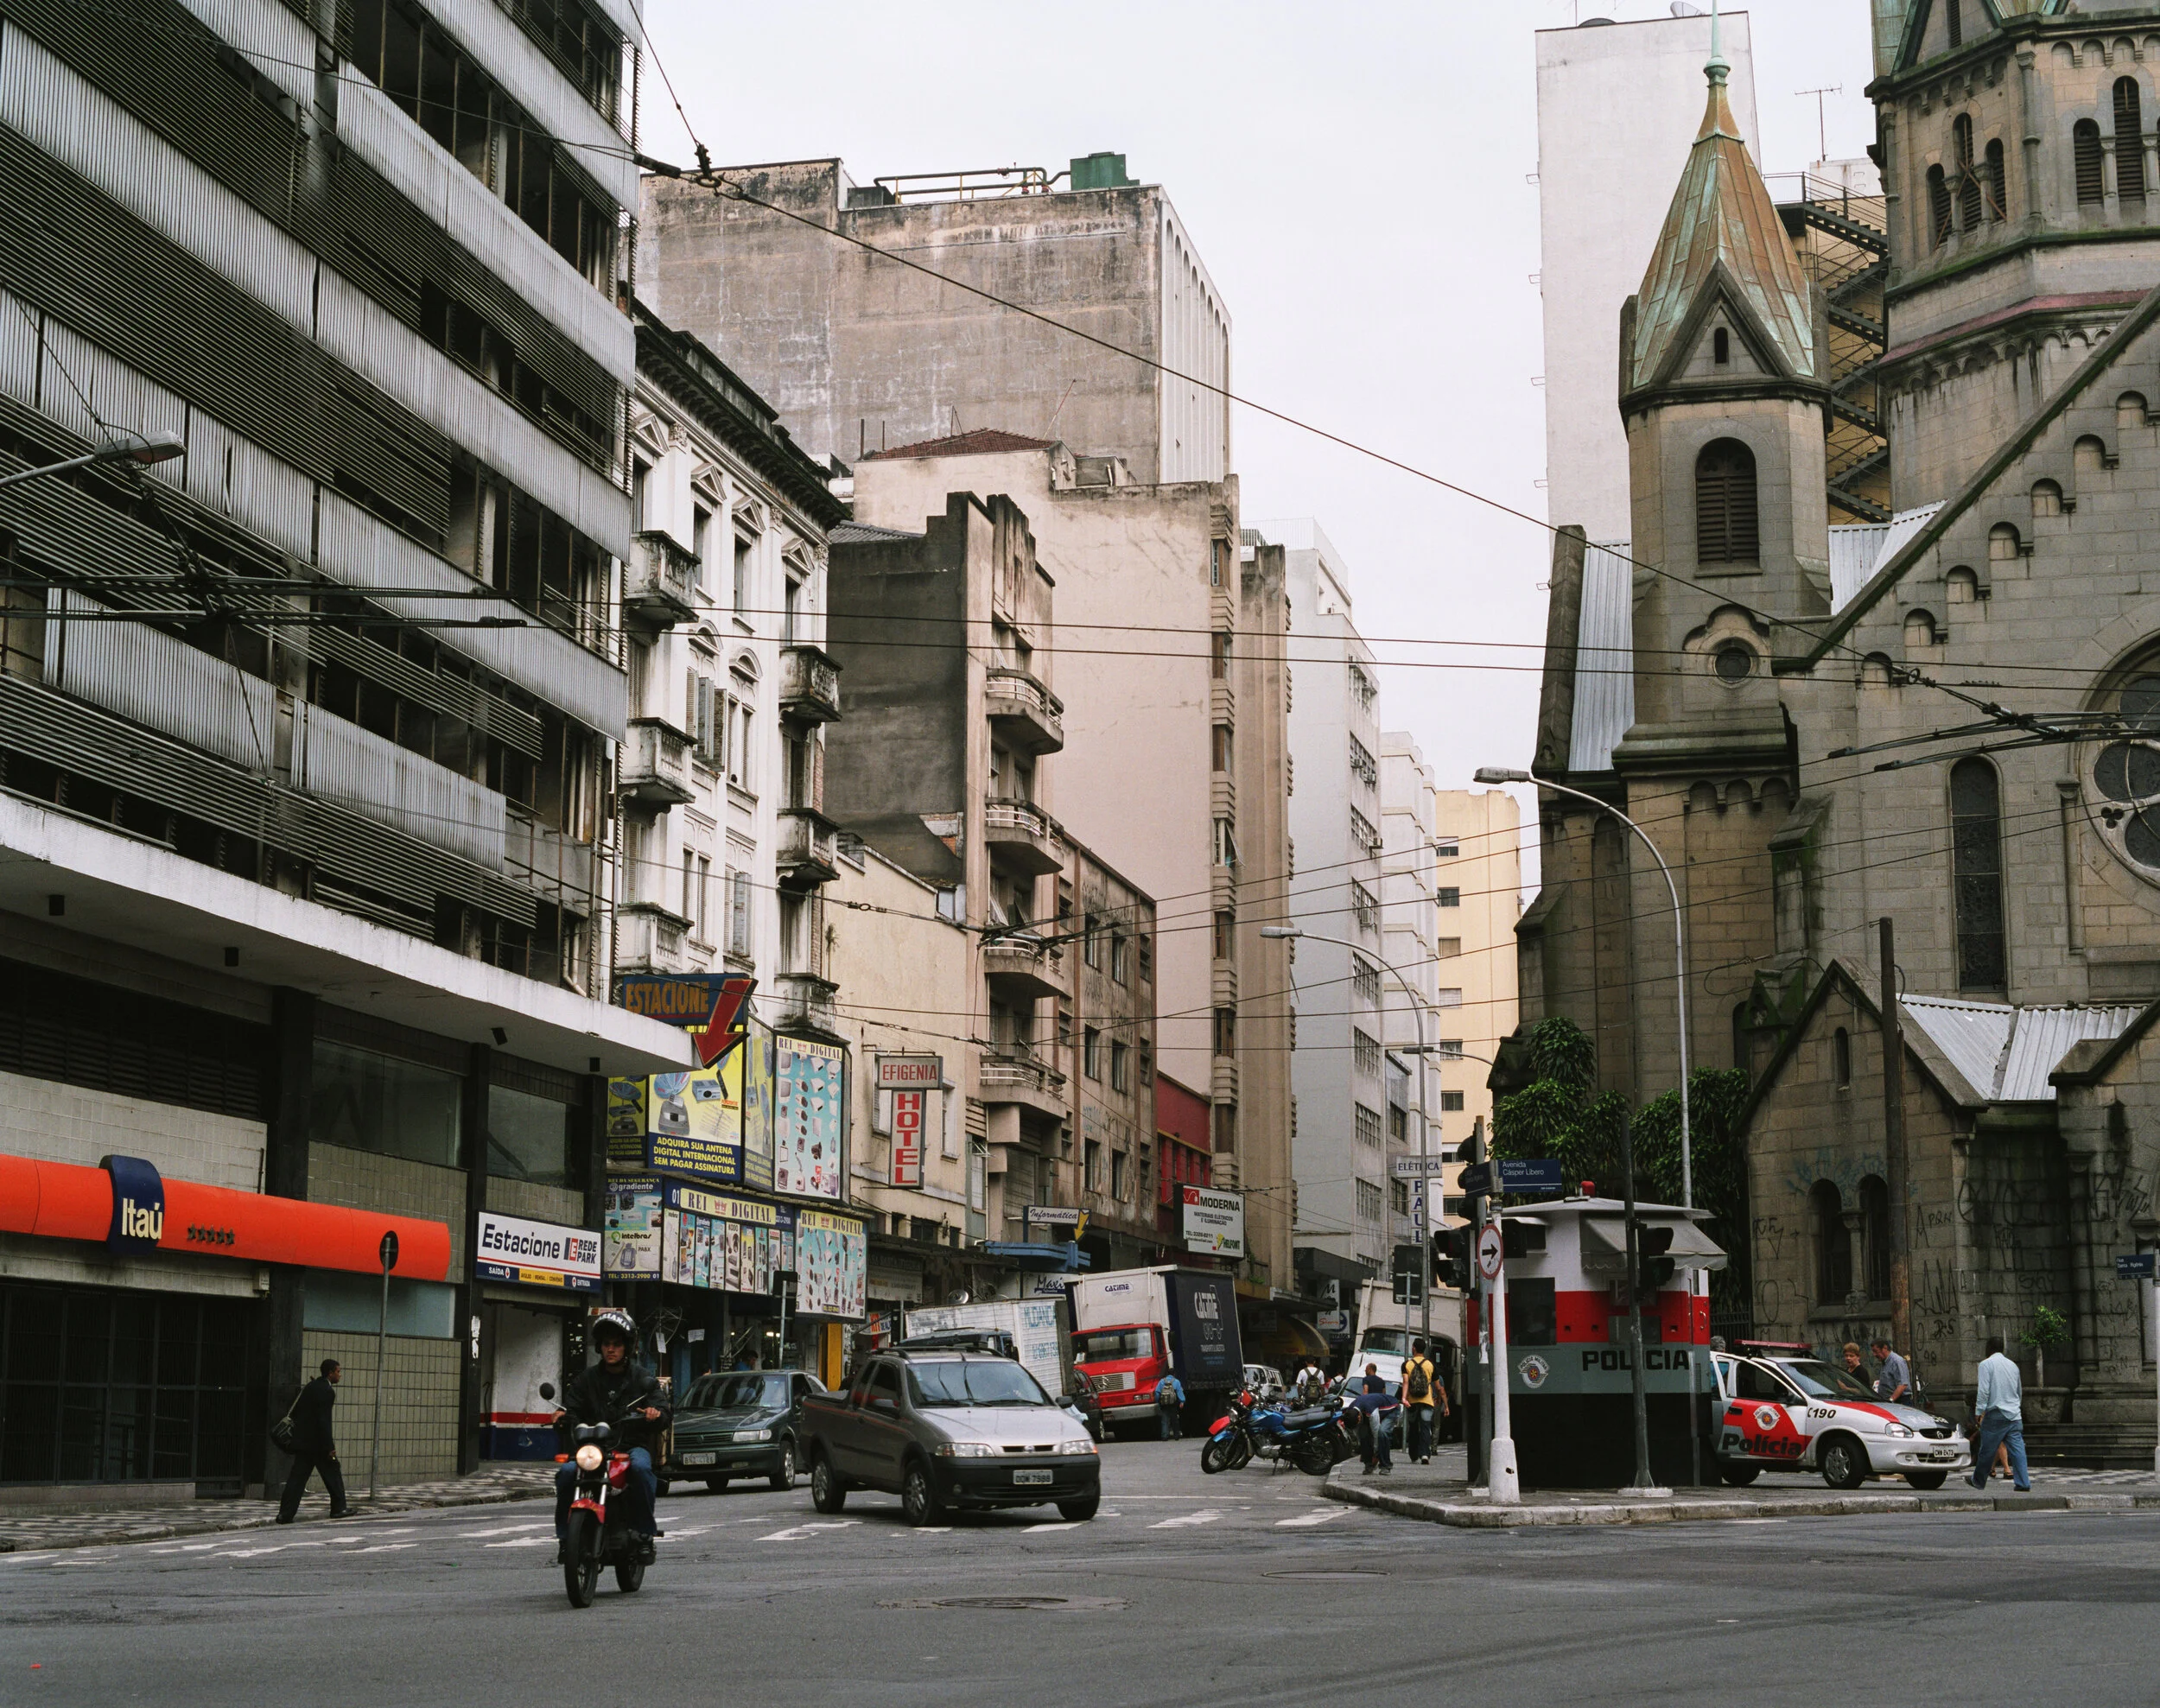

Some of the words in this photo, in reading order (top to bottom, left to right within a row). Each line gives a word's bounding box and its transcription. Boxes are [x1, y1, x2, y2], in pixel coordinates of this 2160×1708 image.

[626, 981, 709, 1014] ESTACIONE
[778, 1038, 792, 1051] REI
[810, 1044, 841, 1060] DIGITAL
[882, 1064, 937, 1081] EFIGENIA
[657, 1136, 689, 1149] ADQUIRA
[690, 1141, 705, 1152] SUA
[705, 1145, 733, 1155] ANTENA
[895, 1093, 920, 1184] HOTEL
[653, 1146, 682, 1159] DIGITAL
[683, 1150, 736, 1165] INTERNACIONAL
[654, 1156, 669, 1166] SEM
[670, 1159, 694, 1170] PAGAR
[694, 1162, 735, 1175] ASSINATURA
[1398, 1161, 1439, 1171] ELÉTCA
[619, 1183, 654, 1191] gradiente
[671, 1188, 680, 1204] 01
[688, 1191, 708, 1211] REI
[731, 1202, 772, 1222] DIGITAL
[1199, 1196, 1241, 1211] MODERNA
[122, 1197, 162, 1240] Itaú
[801, 1212, 816, 1227] REI
[832, 1217, 862, 1235] DIGITAL
[1029, 1208, 1077, 1221] Informática
[481, 1222, 561, 1260] Estacione
[578, 1239, 597, 1253] REDE
[576, 1252, 597, 1265] PARK
[488, 1267, 505, 1276] SAÍDA
[1038, 1273, 1064, 1290] Maxi
[1582, 1349, 1689, 1371] POLCIA
[1813, 1407, 1837, 1419] 190
[1722, 1432, 1801, 1456] Polícia
